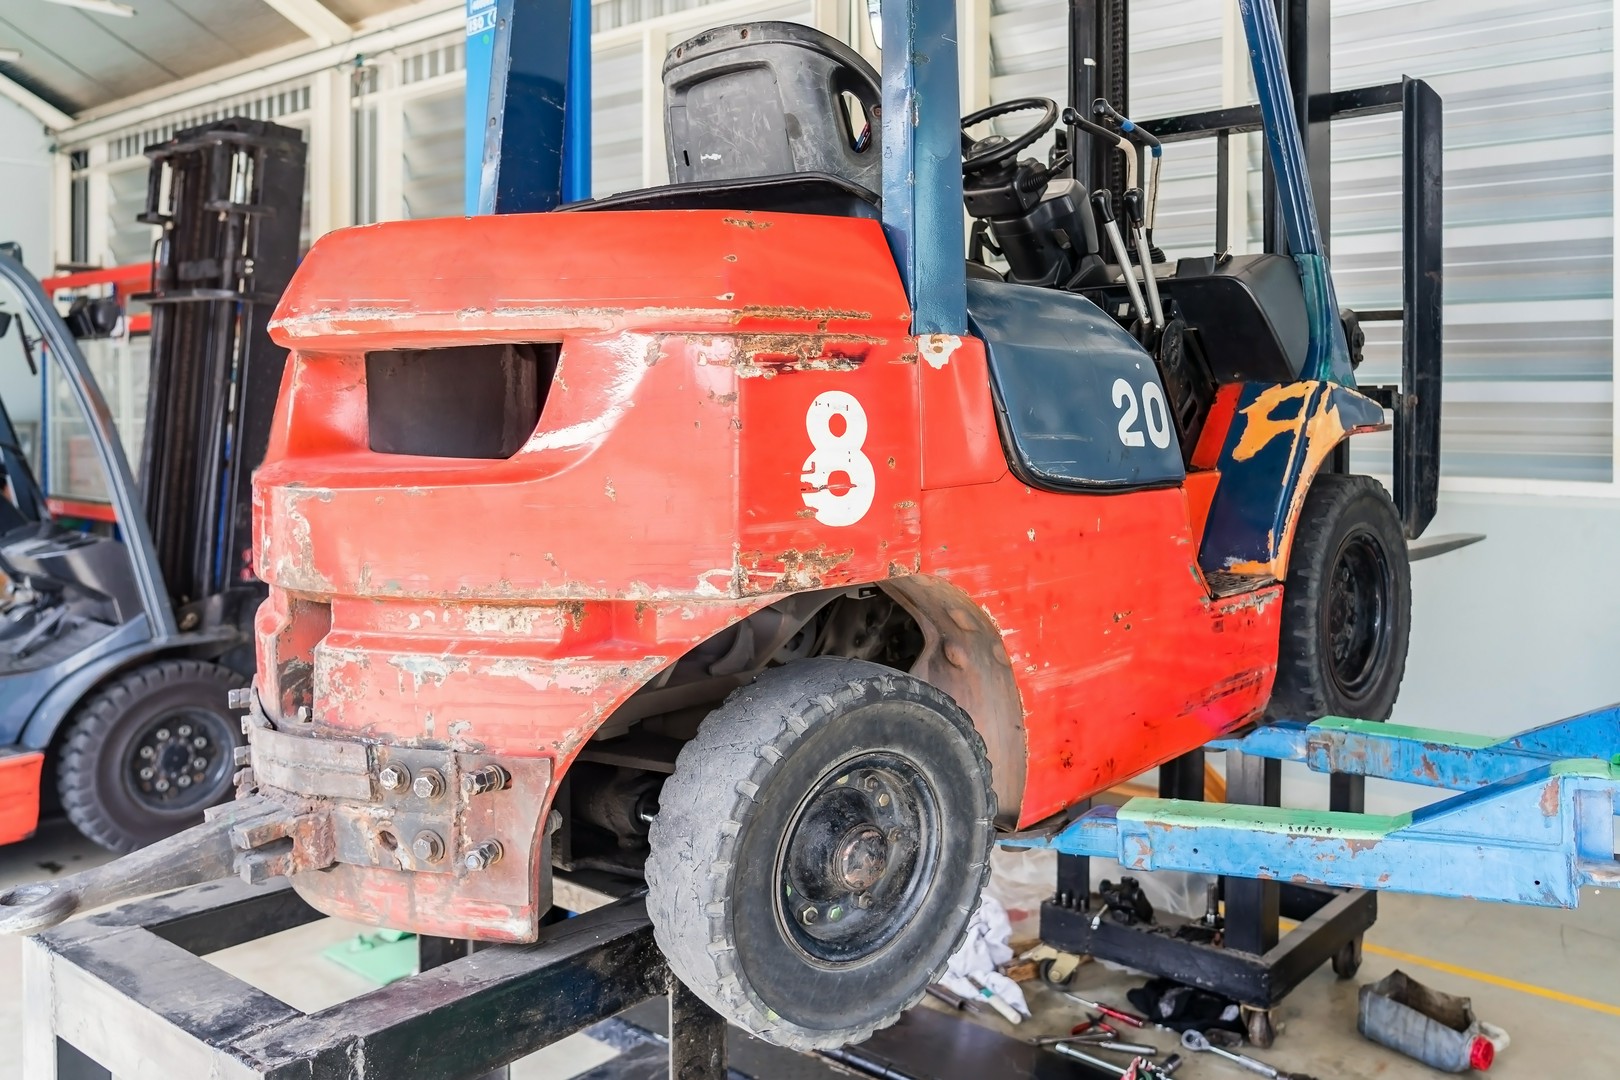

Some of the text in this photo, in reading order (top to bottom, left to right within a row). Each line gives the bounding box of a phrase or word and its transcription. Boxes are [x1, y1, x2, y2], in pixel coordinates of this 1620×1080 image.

[468, 16, 484, 33] ISO
[1112, 378, 1170, 449] 20
[800, 390, 876, 527] 8
